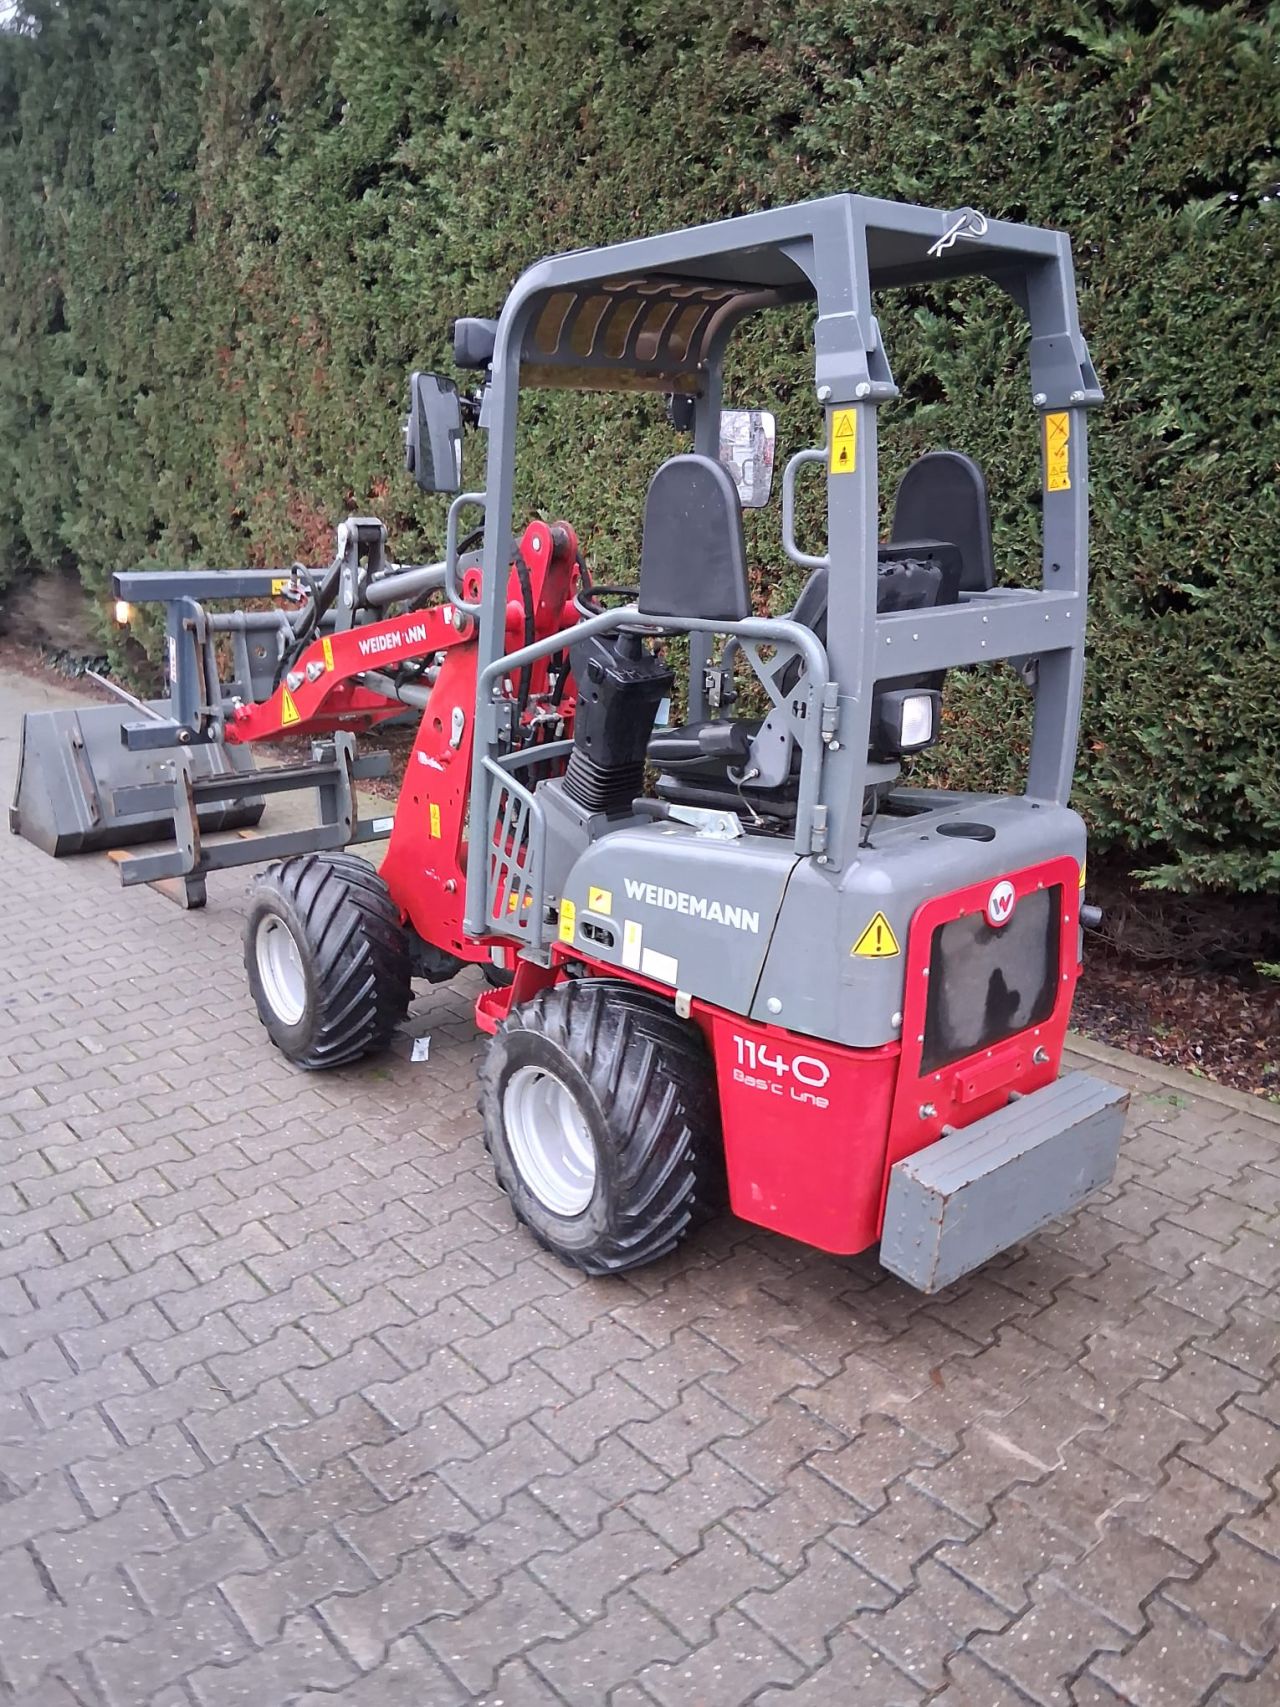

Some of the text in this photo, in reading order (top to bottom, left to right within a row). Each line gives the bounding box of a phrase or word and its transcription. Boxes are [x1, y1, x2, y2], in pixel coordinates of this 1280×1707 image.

[623, 878, 760, 934] WEIDEMANN
[733, 1035, 830, 1088] 1140
[733, 1068, 783, 1096] Basc
